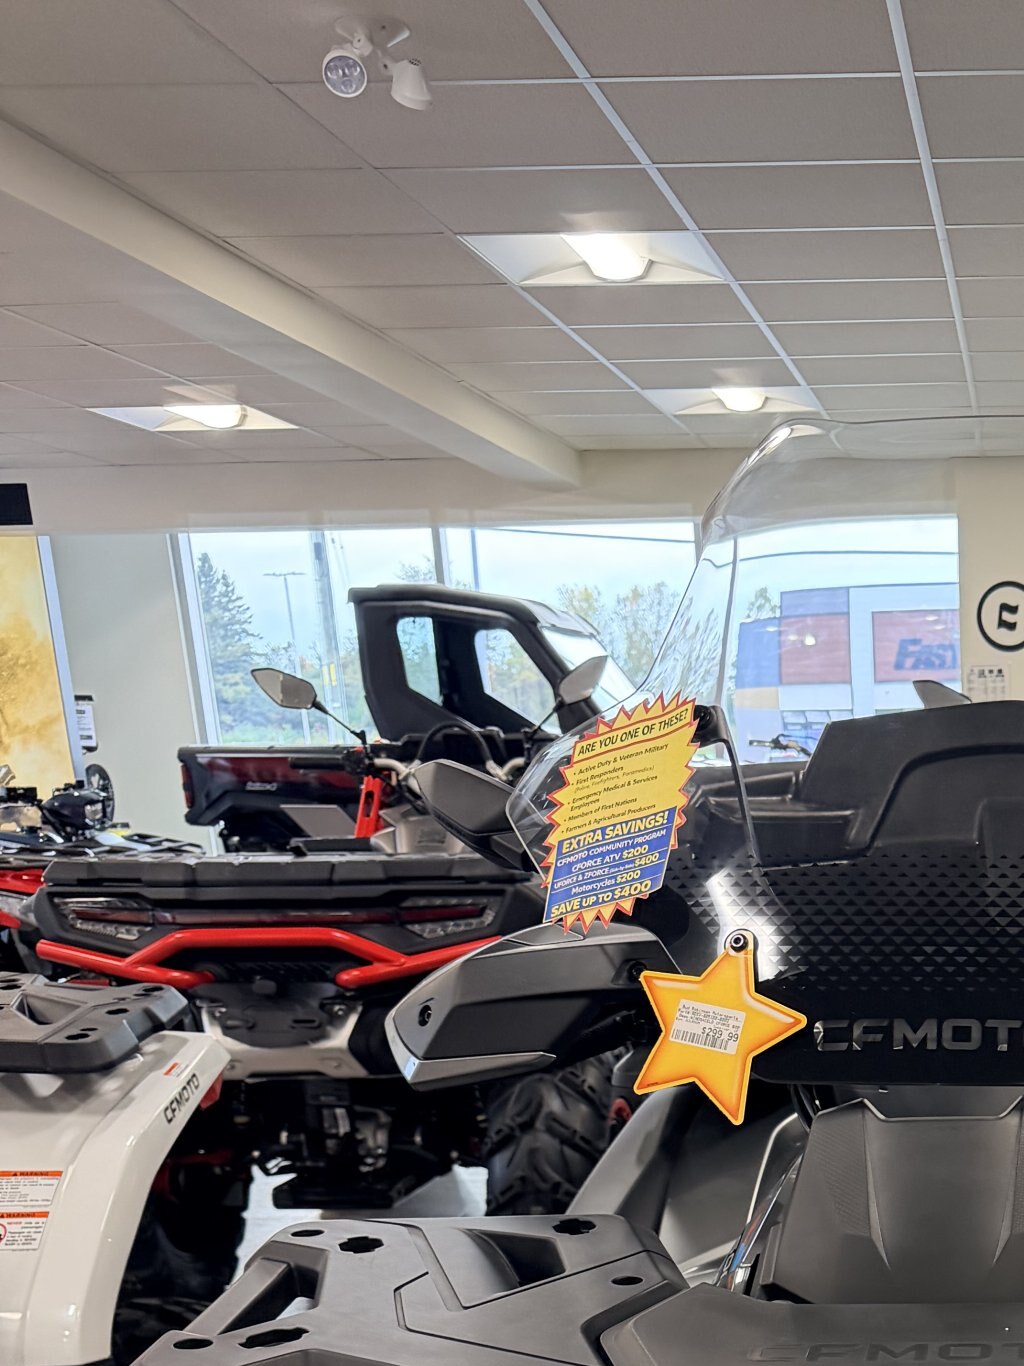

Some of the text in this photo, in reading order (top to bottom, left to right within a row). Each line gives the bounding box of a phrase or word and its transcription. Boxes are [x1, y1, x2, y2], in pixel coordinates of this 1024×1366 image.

[578, 709, 688, 756] ARE YOU ONE OF THESE?
[578, 766, 596, 775] Active
[597, 760, 611, 769] Duty
[620, 750, 643, 761] Veteran
[644, 743, 669, 754] Military
[572, 790, 602, 804] Emergency
[603, 781, 626, 793] Medical
[633, 775, 658, 785] Services
[576, 766, 624, 786] First Responders
[566, 823, 587, 834] Farmers
[593, 810, 626, 825] Agricultural
[627, 804, 656, 816] Producers
[568, 810, 593, 822] Members
[601, 802, 614, 810] First
[615, 798, 638, 808] Nations
[570, 798, 600, 812] Employees
[557, 829, 666, 867] CFMOTO COMMUNITY PROGRAM
[562, 811, 669, 854] EXTRA SAVINGS!
[554, 876, 577, 888] UFORCE
[584, 868, 609, 879] ZFORCE
[634, 853, 659, 867] $400
[572, 845, 649, 872] CFORCE ATV $200
[572, 870, 641, 895] Motorcycles $200
[551, 880, 652, 918] SAVE UP TO $400
[164, 1073, 200, 1125] CFMOTO
